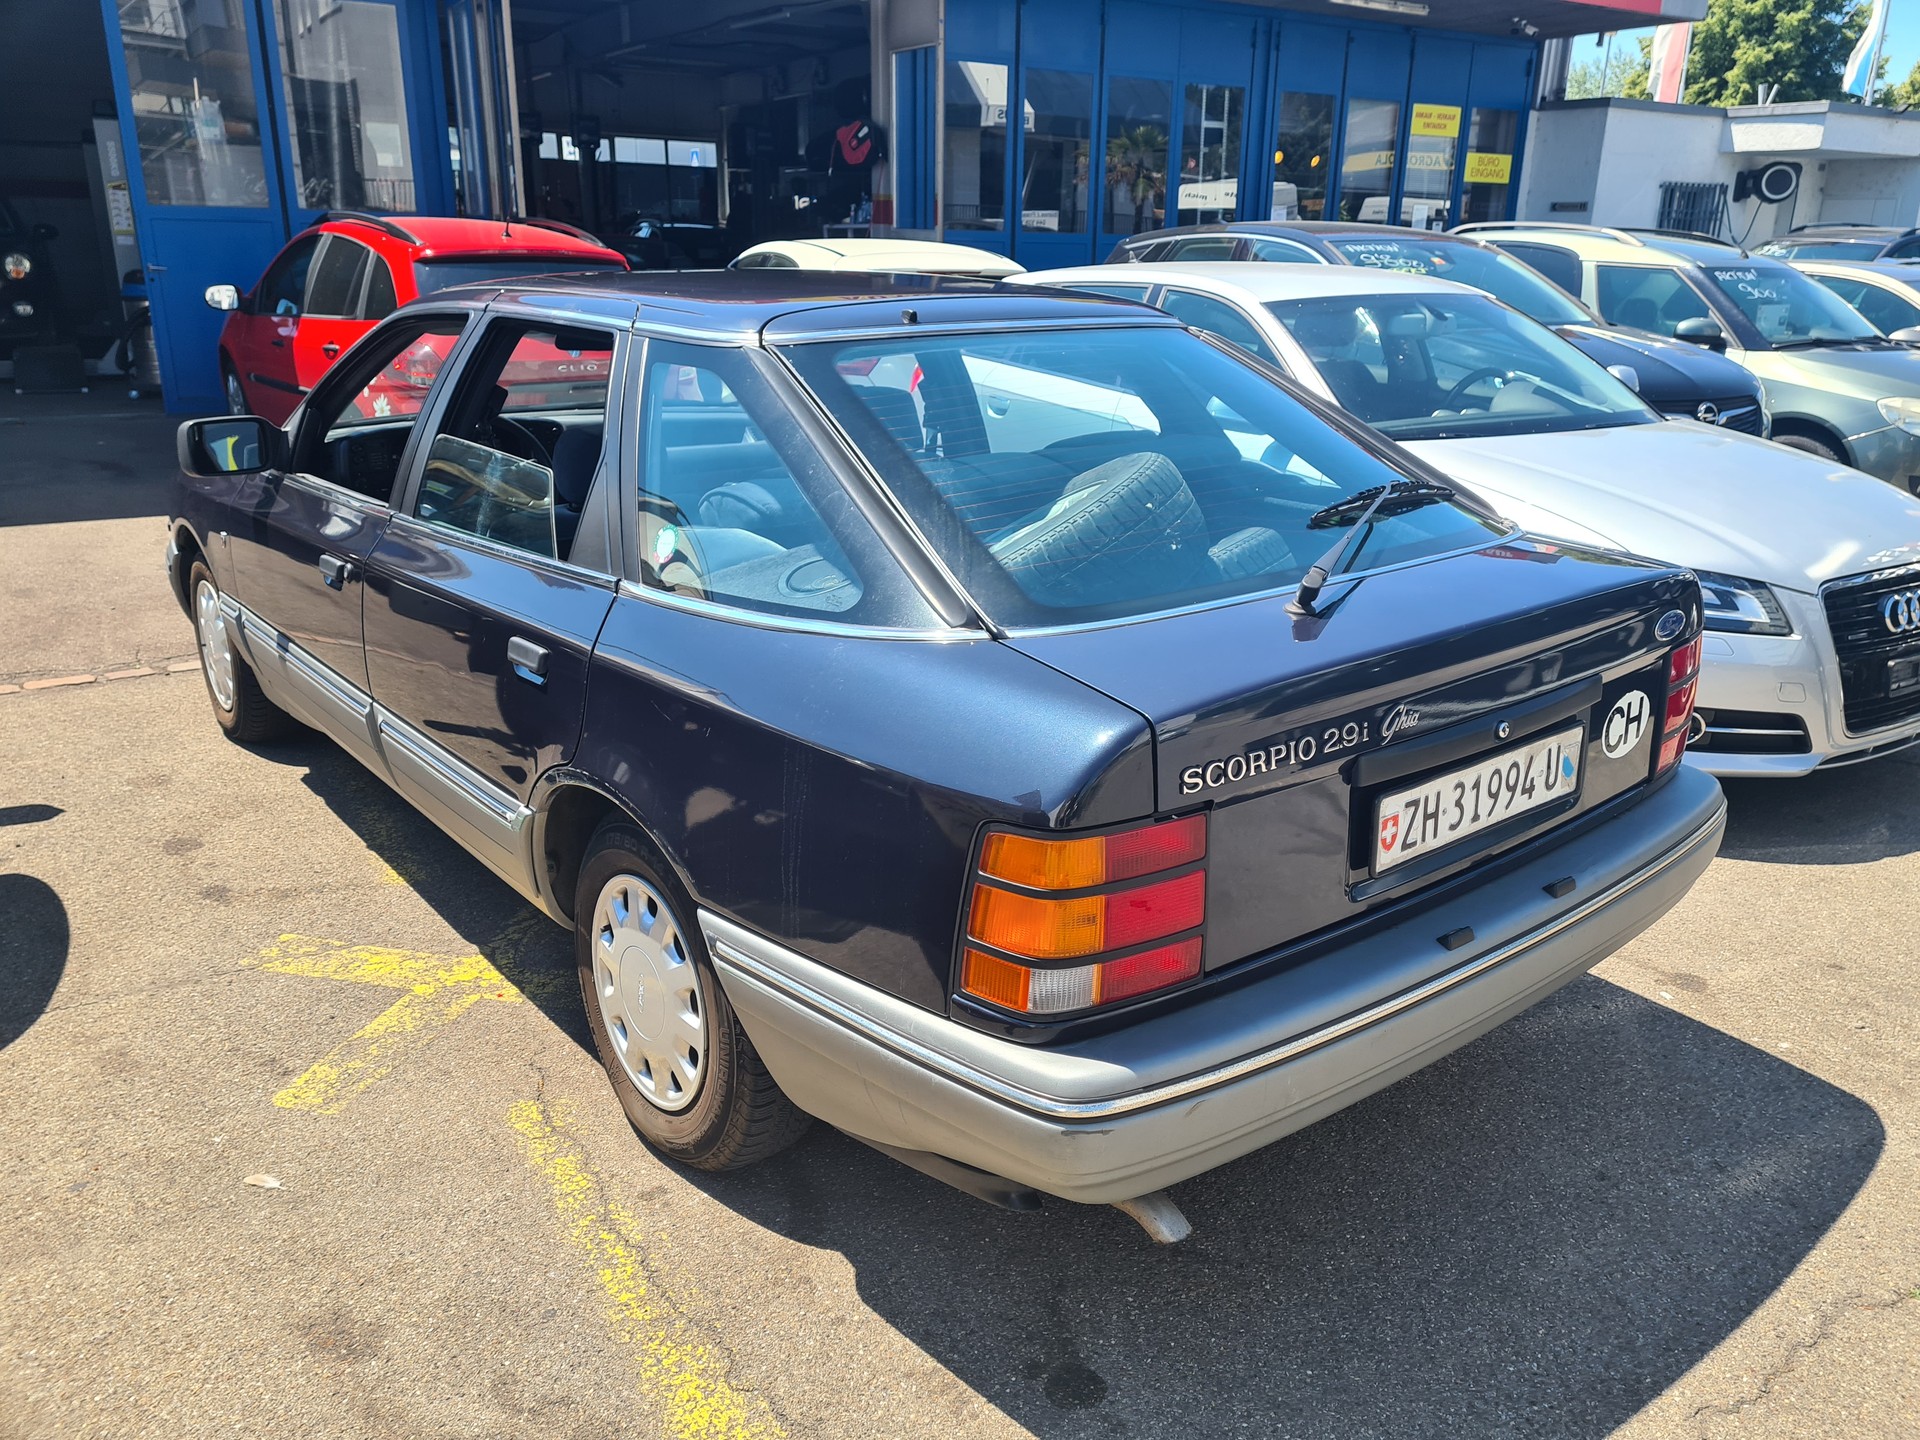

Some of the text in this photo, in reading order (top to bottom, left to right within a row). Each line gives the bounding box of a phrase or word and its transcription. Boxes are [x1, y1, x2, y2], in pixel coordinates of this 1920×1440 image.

[1470, 167, 1505, 179] EINGANG
[557, 363, 598, 373] CLIO
[1605, 696, 1645, 754] CH
[1182, 735, 1317, 796] SCORPIO
[1381, 703, 1421, 746] Ghia
